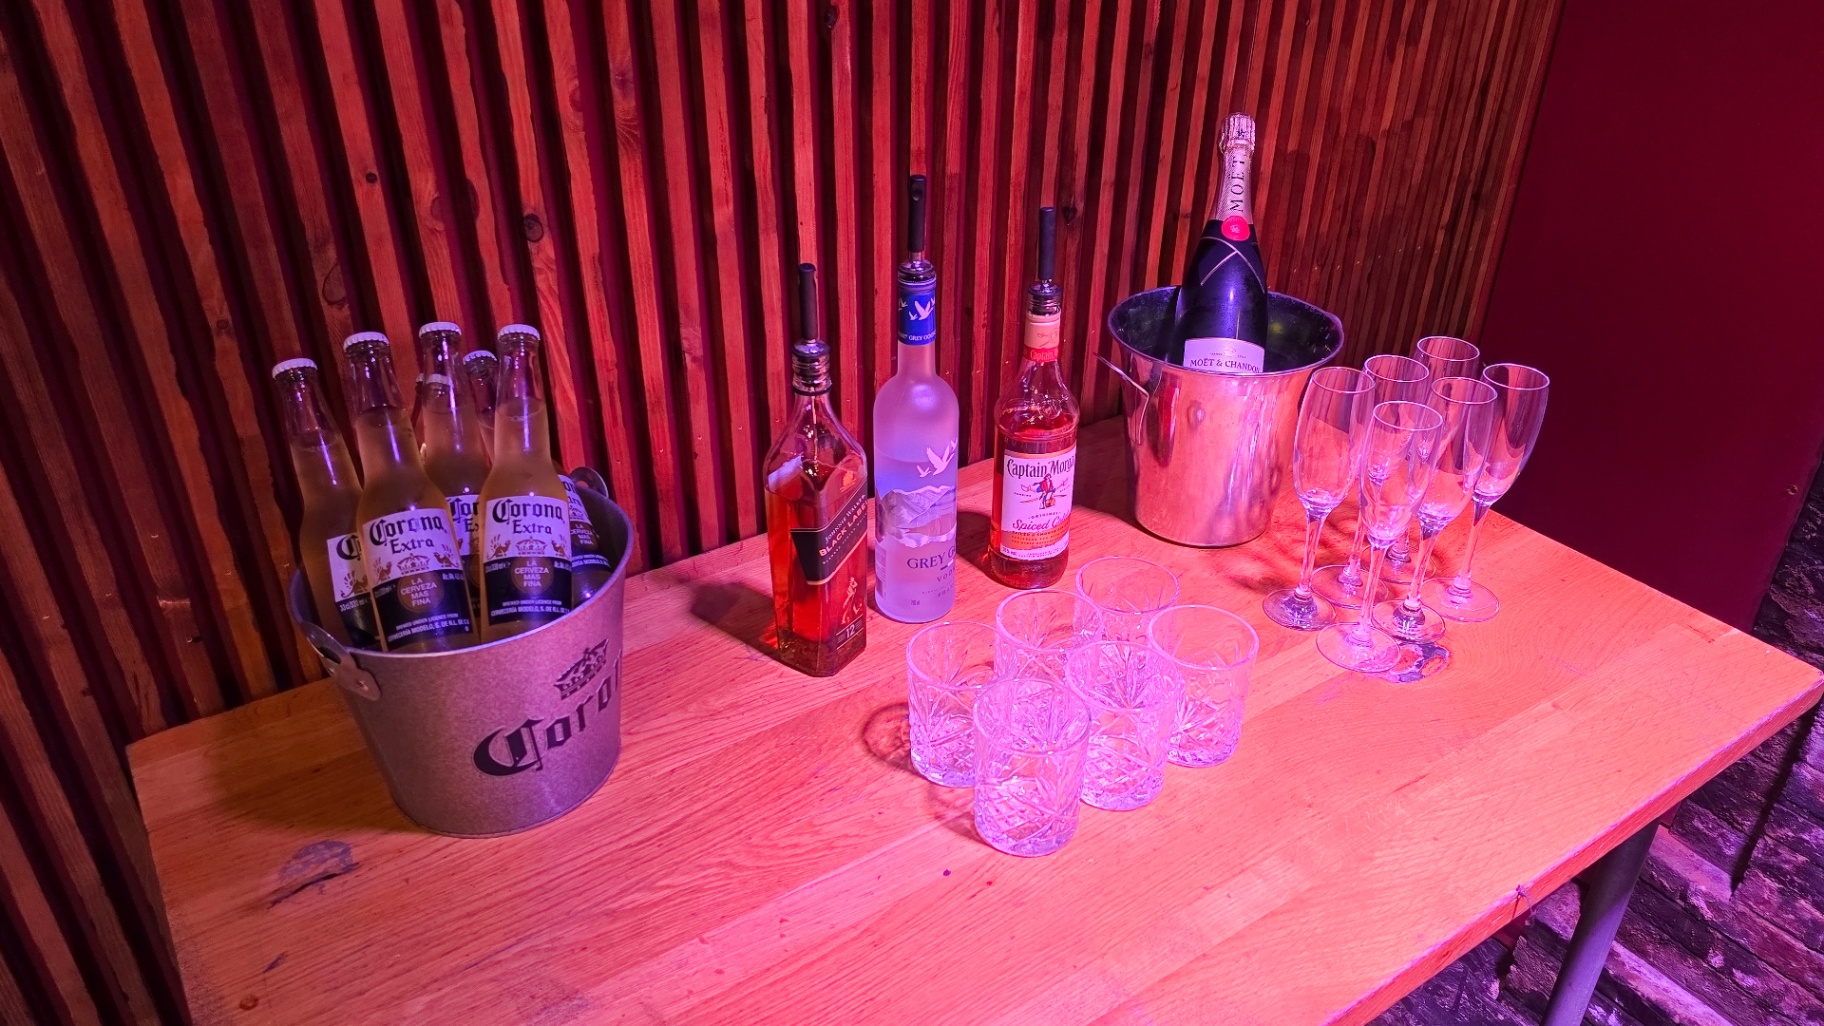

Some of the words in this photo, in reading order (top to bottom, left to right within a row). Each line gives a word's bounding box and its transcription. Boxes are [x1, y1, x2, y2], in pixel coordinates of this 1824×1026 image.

[1229, 156, 1245, 212] MOËT
[1189, 357, 1215, 367] MOËT
[1216, 359, 1223, 367] &
[1224, 360, 1260, 374] CHANDON
[1007, 458, 1047, 479] Captain
[492, 498, 564, 525] Corona
[369, 515, 445, 547] Corona
[512, 519, 552, 535] Extra
[1012, 519, 1051, 531] Spiced
[390, 537, 435, 554] Extra
[819, 526, 847, 556] BLACK
[526, 559, 538, 567] LA
[907, 552, 946, 569] GREY
[400, 582, 438, 595] CERVEZA
[411, 577, 424, 586] LA
[411, 591, 430, 600] MAS
[411, 597, 432, 607] FINA
[845, 623, 856, 639] 12
